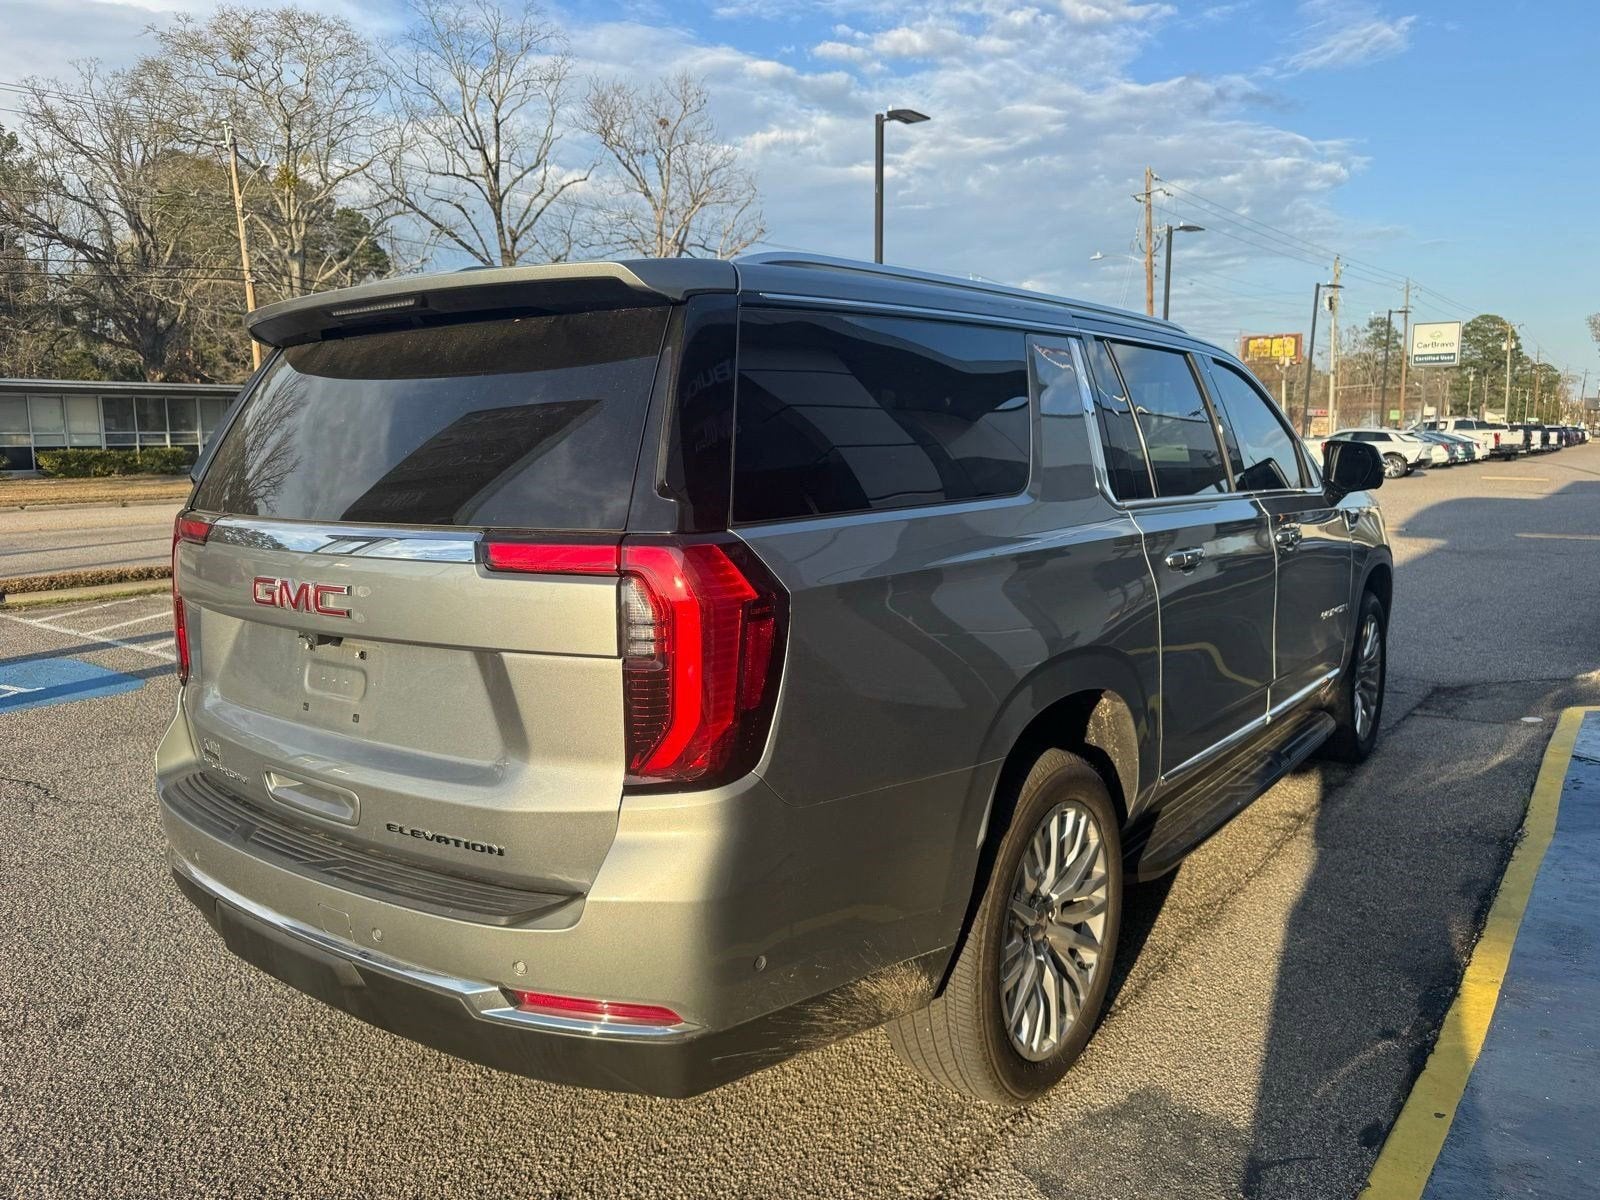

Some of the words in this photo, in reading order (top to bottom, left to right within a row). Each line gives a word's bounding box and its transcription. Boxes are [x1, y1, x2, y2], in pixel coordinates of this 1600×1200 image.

[1417, 341, 1455, 349] CarBravo
[253, 576, 353, 619] GMC
[385, 820, 506, 857] ELEVATION
